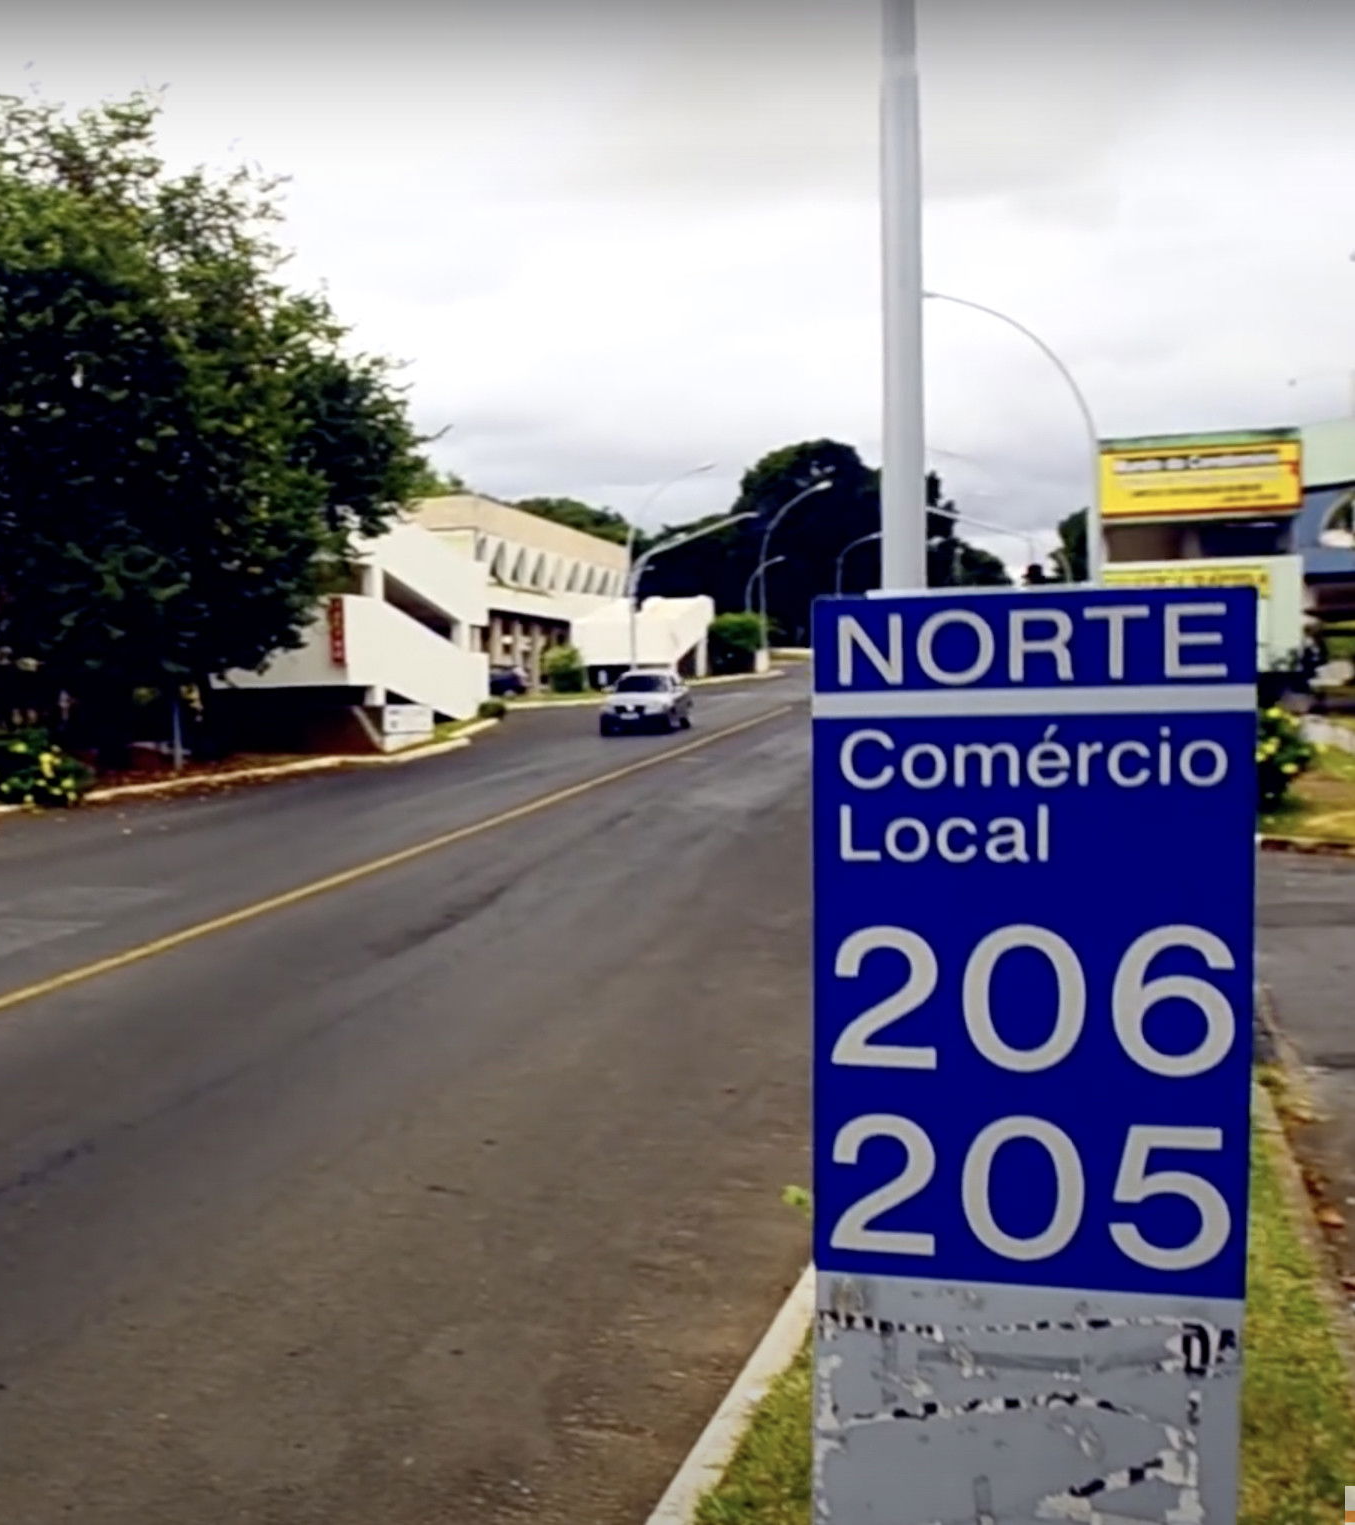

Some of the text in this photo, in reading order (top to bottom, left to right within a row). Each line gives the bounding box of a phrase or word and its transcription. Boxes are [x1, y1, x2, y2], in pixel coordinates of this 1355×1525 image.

[837, 603, 1229, 686] NORTE
[839, 724, 1229, 789] Comércio
[839, 804, 1049, 863] Local
[831, 924, 1236, 1077] 206
[830, 1114, 1232, 1271] 205
